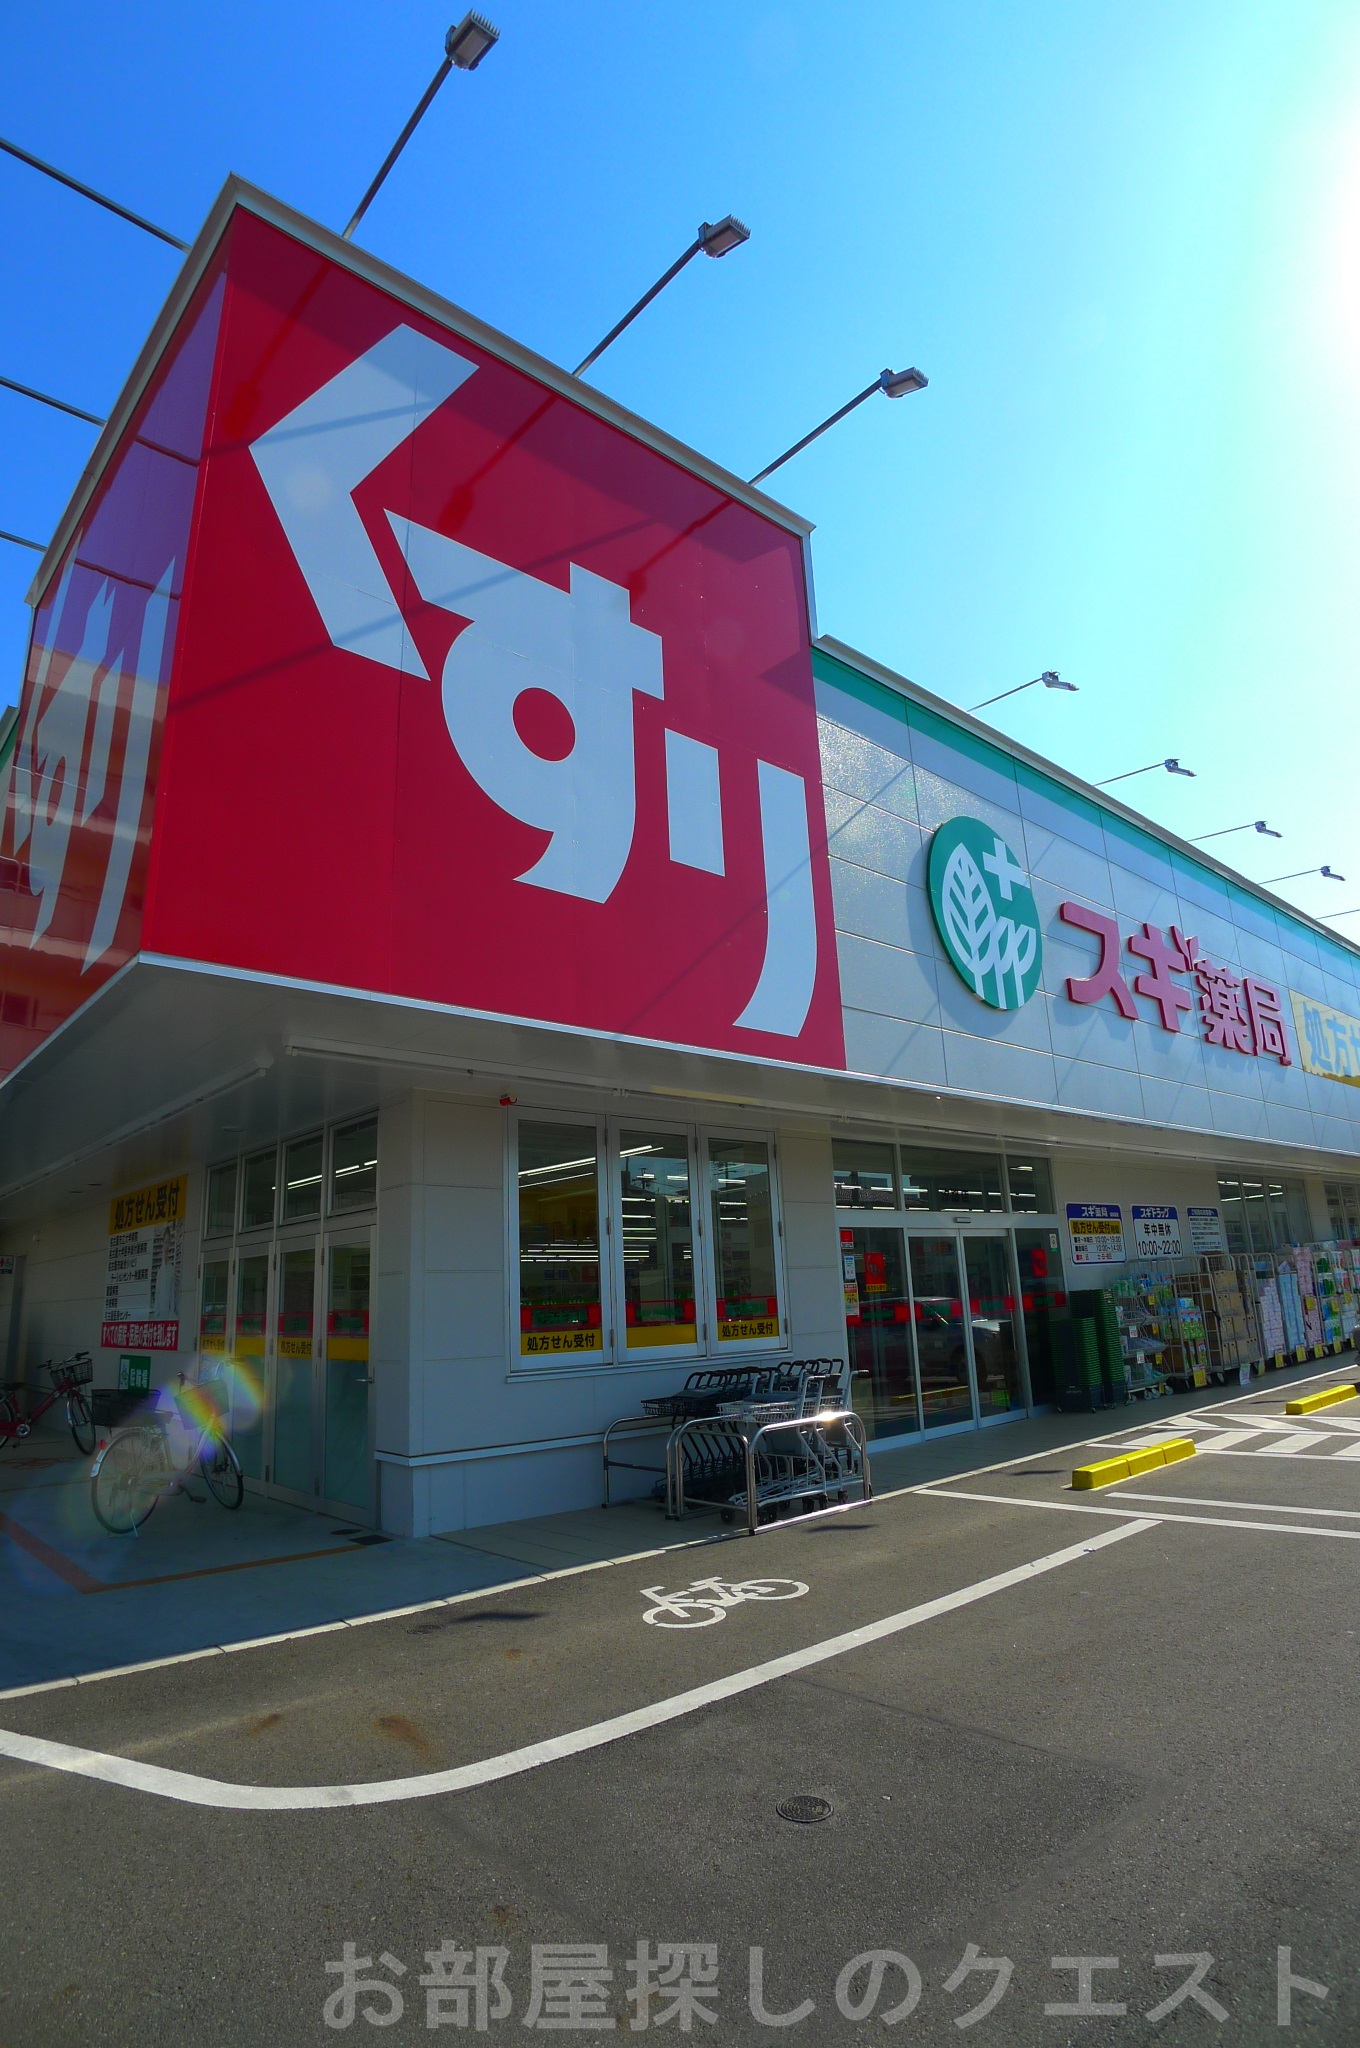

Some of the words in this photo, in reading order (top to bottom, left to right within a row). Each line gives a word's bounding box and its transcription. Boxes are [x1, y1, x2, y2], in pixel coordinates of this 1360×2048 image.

[249, 324, 818, 1037] くすり
[1060, 901, 1292, 1066] スギ薬局
[115, 1183, 180, 1230] 処方せん受付
[1140, 1207, 1170, 1218] スギドラッグ
[1144, 1223, 1171, 1237] 年中無休
[722, 1322, 773, 1338] 処方せん受付
[280, 1339, 312, 1355] 処方せん受付
[527, 1333, 595, 1351] 処方せん受付
